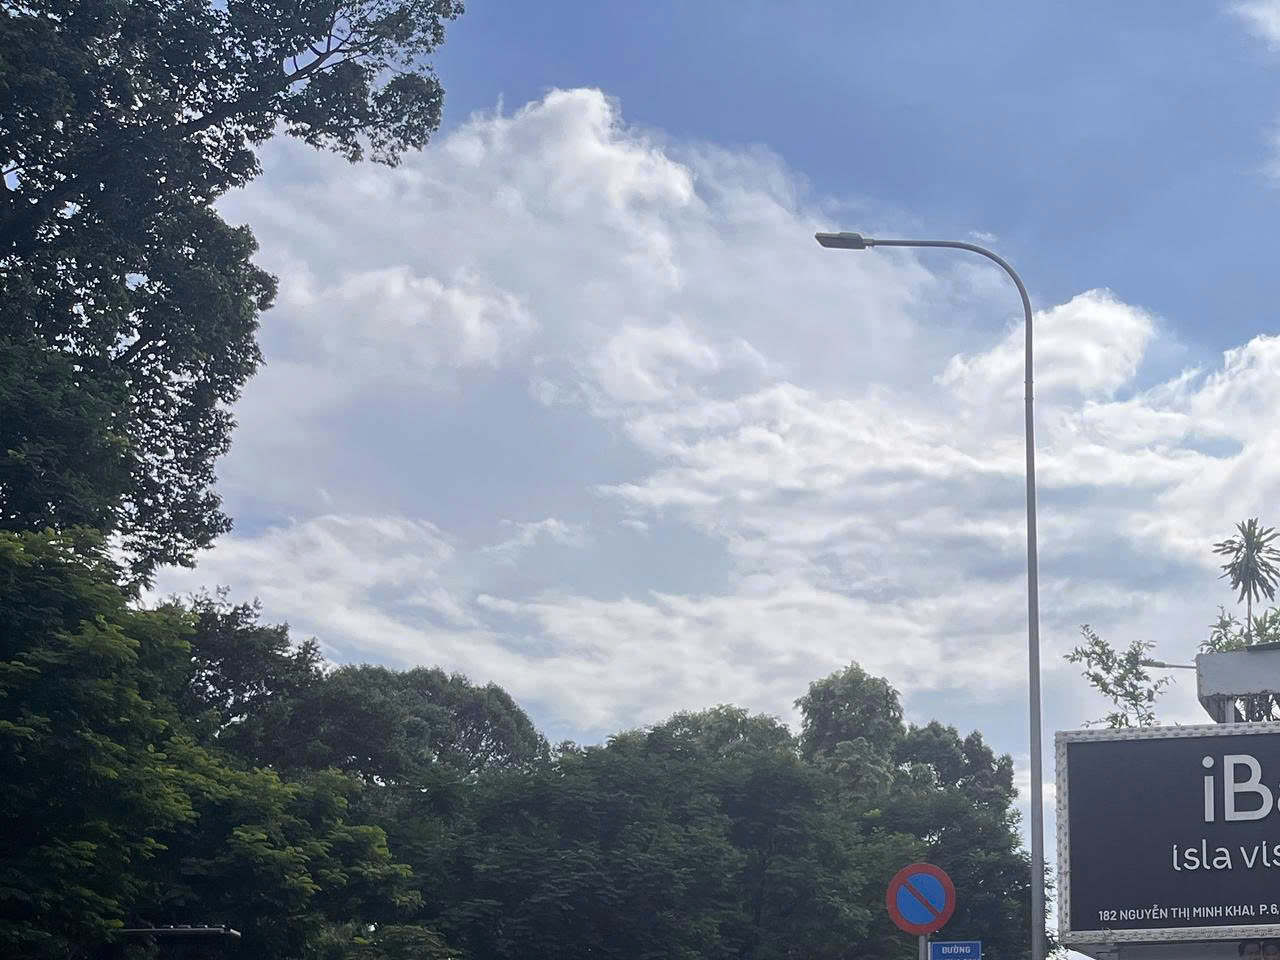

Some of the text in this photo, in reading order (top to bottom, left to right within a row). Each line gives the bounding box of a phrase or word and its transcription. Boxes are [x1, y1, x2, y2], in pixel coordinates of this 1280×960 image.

[1172, 838, 1233, 871] isla
[1099, 909, 1117, 921] 182
[1120, 904, 1168, 921] NGUYỄN
[1171, 907, 1190, 920] THỊ
[1193, 905, 1222, 918] MINH
